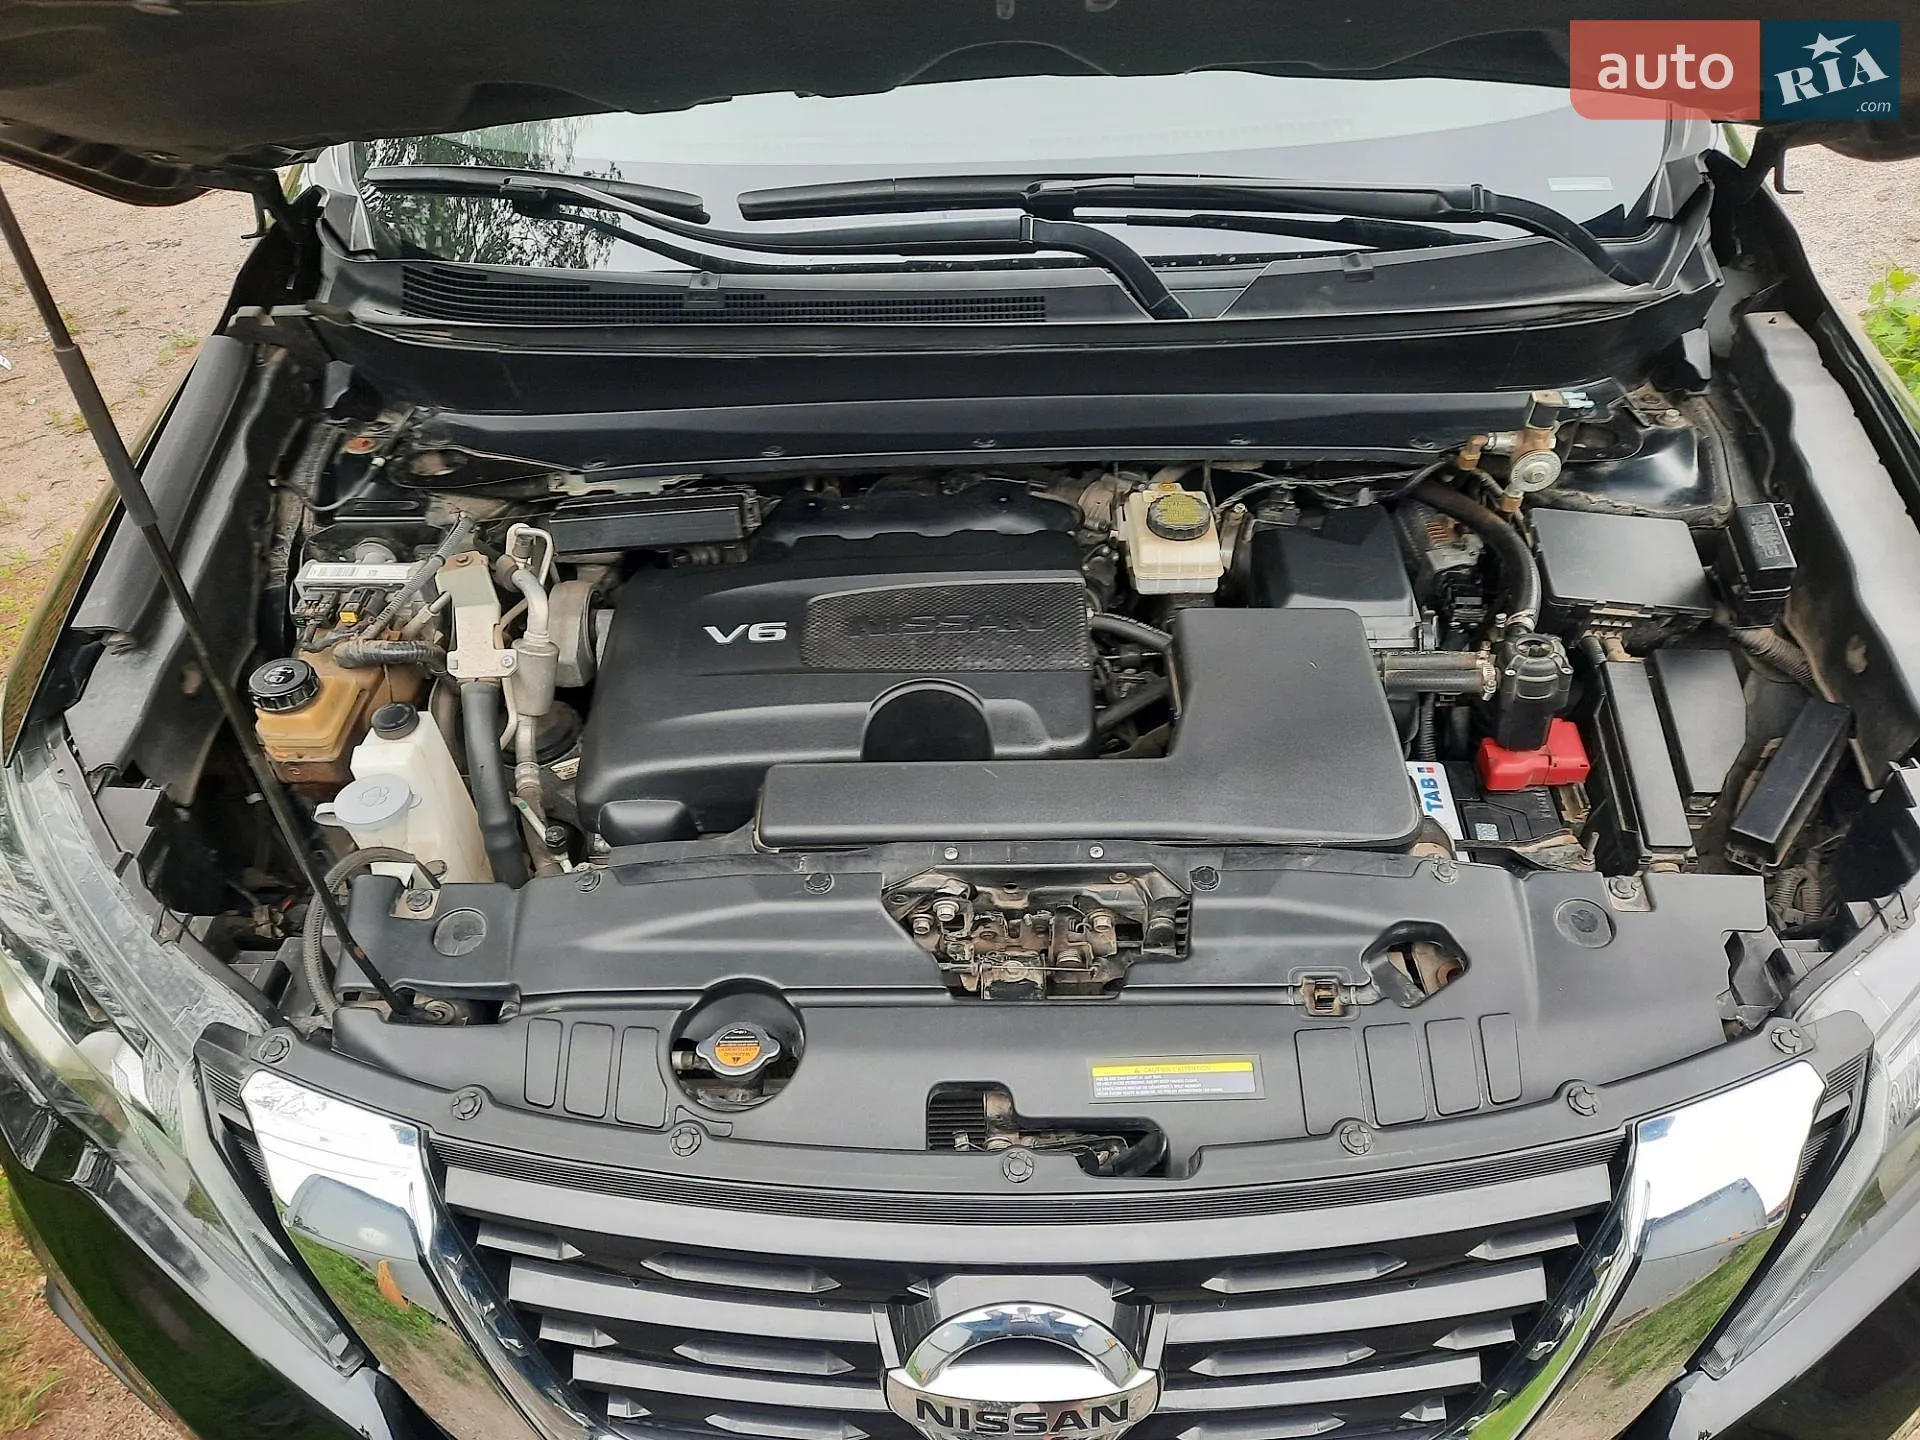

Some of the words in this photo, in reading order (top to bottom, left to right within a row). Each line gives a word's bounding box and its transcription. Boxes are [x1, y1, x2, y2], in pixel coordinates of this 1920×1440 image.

[702, 621, 788, 644] V6
[849, 612, 1046, 638] NISSAN
[1420, 777, 1444, 812] TAB
[915, 1398, 1129, 1435] NISSAN
